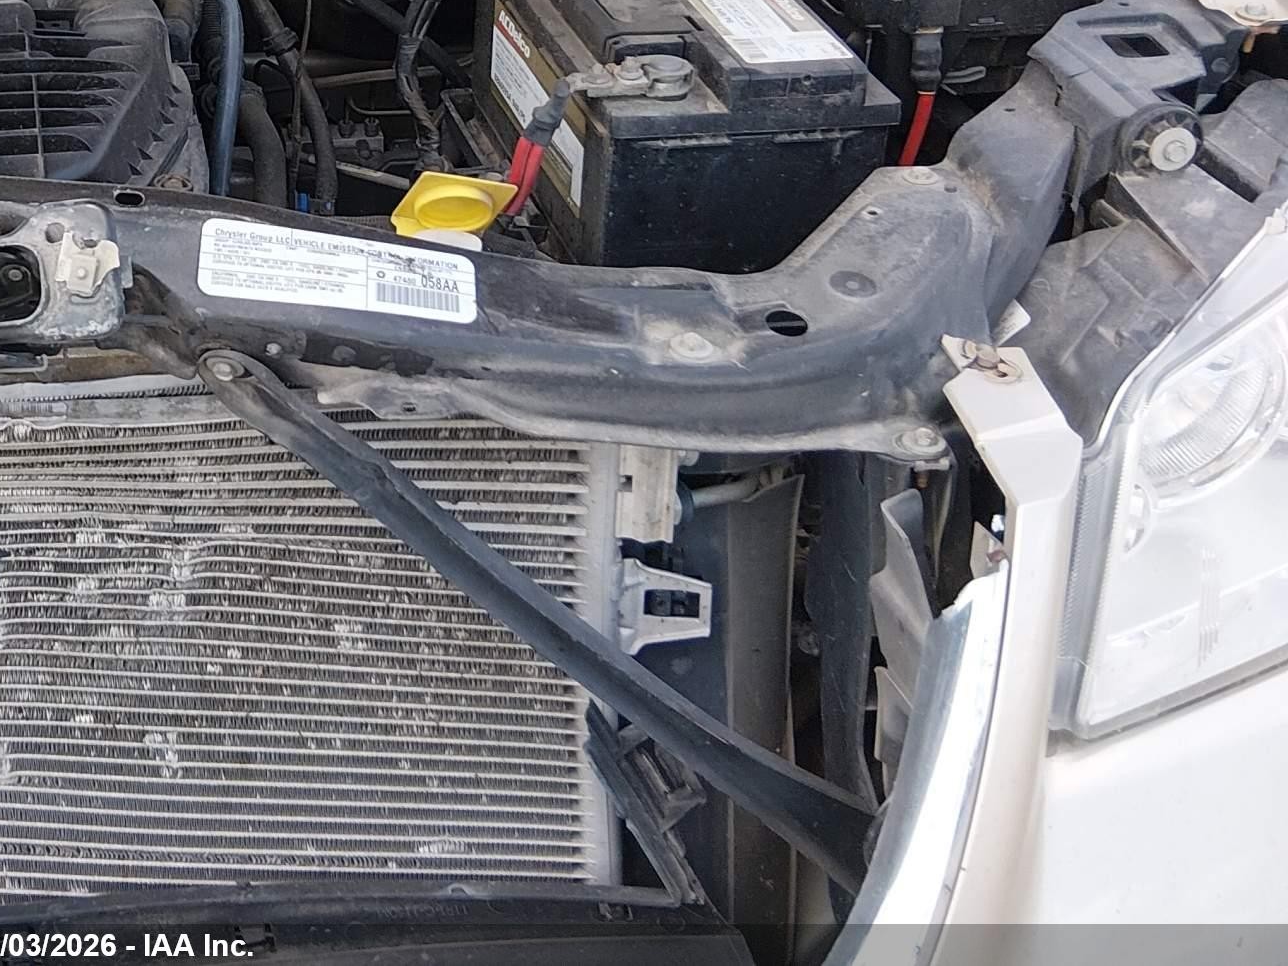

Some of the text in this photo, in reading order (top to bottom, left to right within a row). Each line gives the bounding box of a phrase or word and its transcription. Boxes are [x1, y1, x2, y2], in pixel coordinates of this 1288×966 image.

[215, 227, 248, 239] Chrysler
[250, 232, 273, 243] Group
[276, 235, 291, 245] LLC
[294, 238, 326, 251] VEHICLE
[420, 273, 460, 293] 058AA
